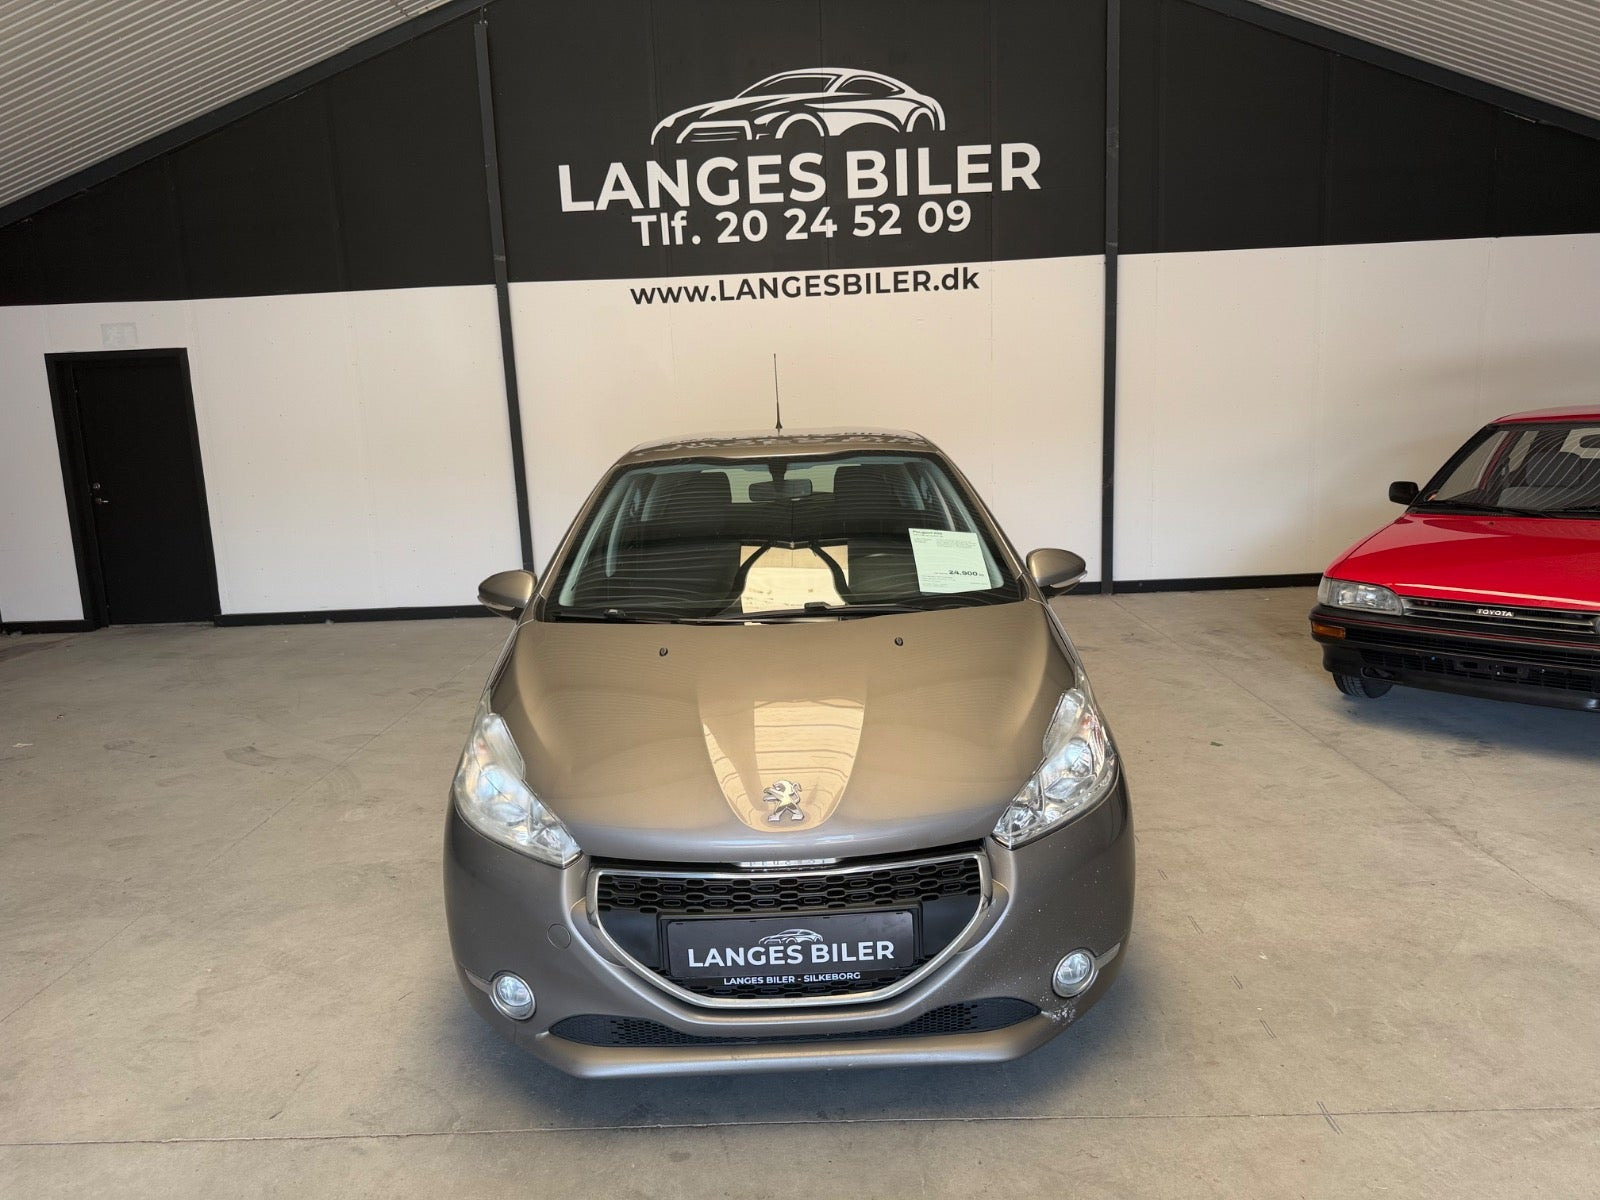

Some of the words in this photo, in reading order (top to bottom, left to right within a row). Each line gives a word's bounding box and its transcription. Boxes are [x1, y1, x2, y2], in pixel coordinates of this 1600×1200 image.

[558, 152, 827, 213] LANGES
[846, 142, 1041, 199] BILER
[631, 211, 701, 247] Tlf.
[715, 209, 768, 244] 20
[783, 206, 838, 241] 24
[852, 203, 902, 237] 52
[917, 200, 972, 234] 09
[630, 266, 980, 305] www.LANGESBILER.dk
[948, 569, 978, 577] 24.900
[1477, 608, 1513, 617] TOYOTA
[687, 944, 804, 968] LANGES
[810, 940, 895, 964] BILER
[723, 976, 765, 986] LANGES
[766, 975, 796, 985] BILER
[803, 971, 861, 983] SILKEBORG
